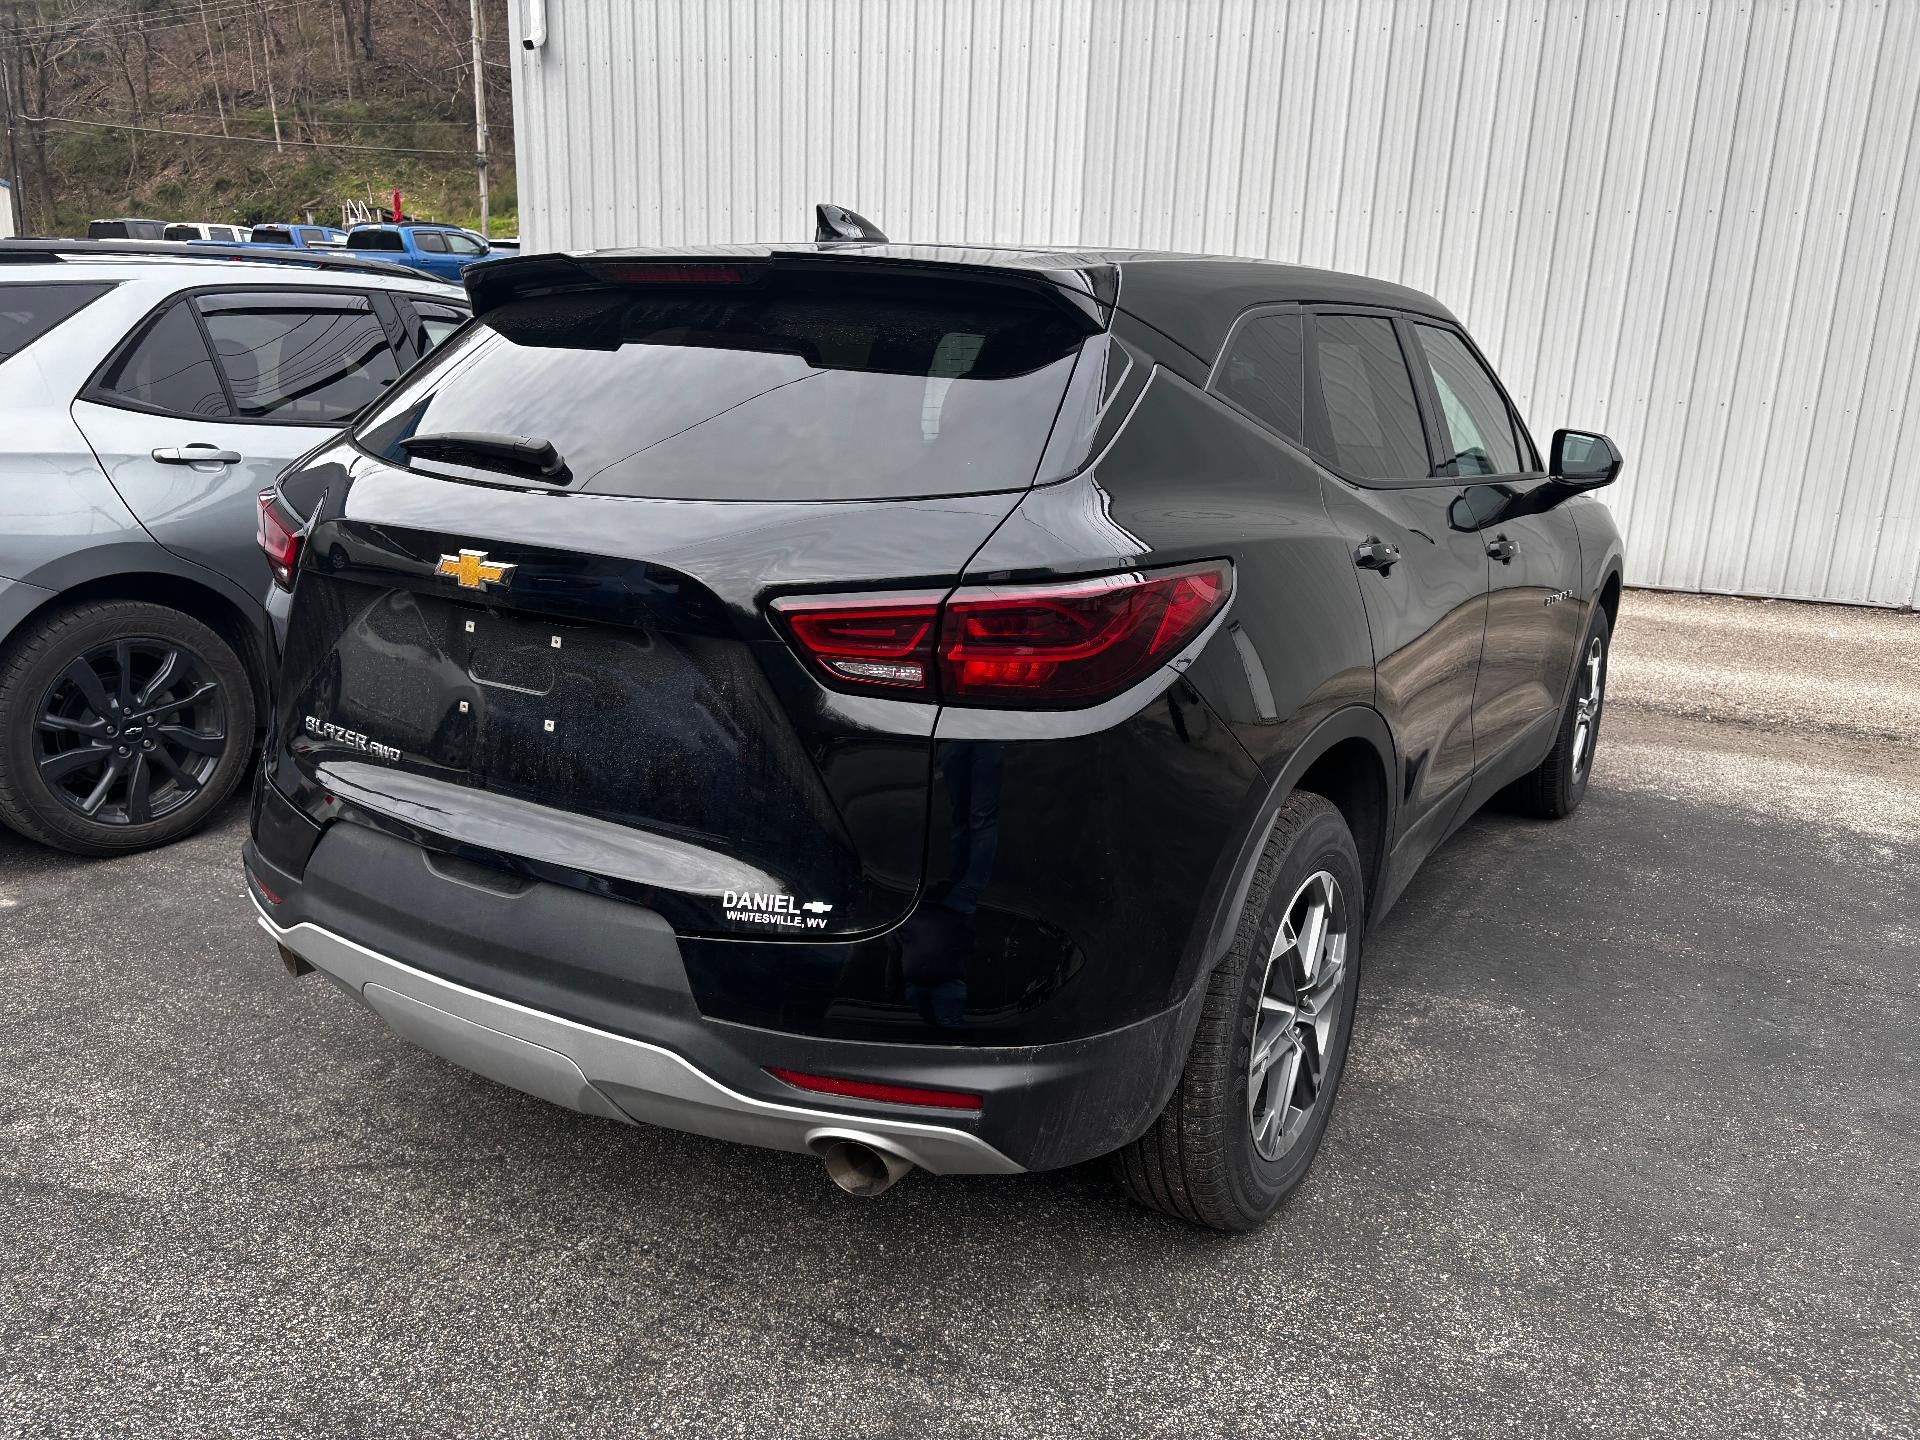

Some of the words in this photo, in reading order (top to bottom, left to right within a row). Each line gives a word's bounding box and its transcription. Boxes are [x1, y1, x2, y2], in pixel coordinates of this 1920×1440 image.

[305, 715, 368, 750] BLAZER
[369, 740, 402, 761] AWD
[722, 890, 801, 914] DANIEL
[726, 910, 805, 929] WHITESVILLE,
[806, 917, 828, 929] WV
